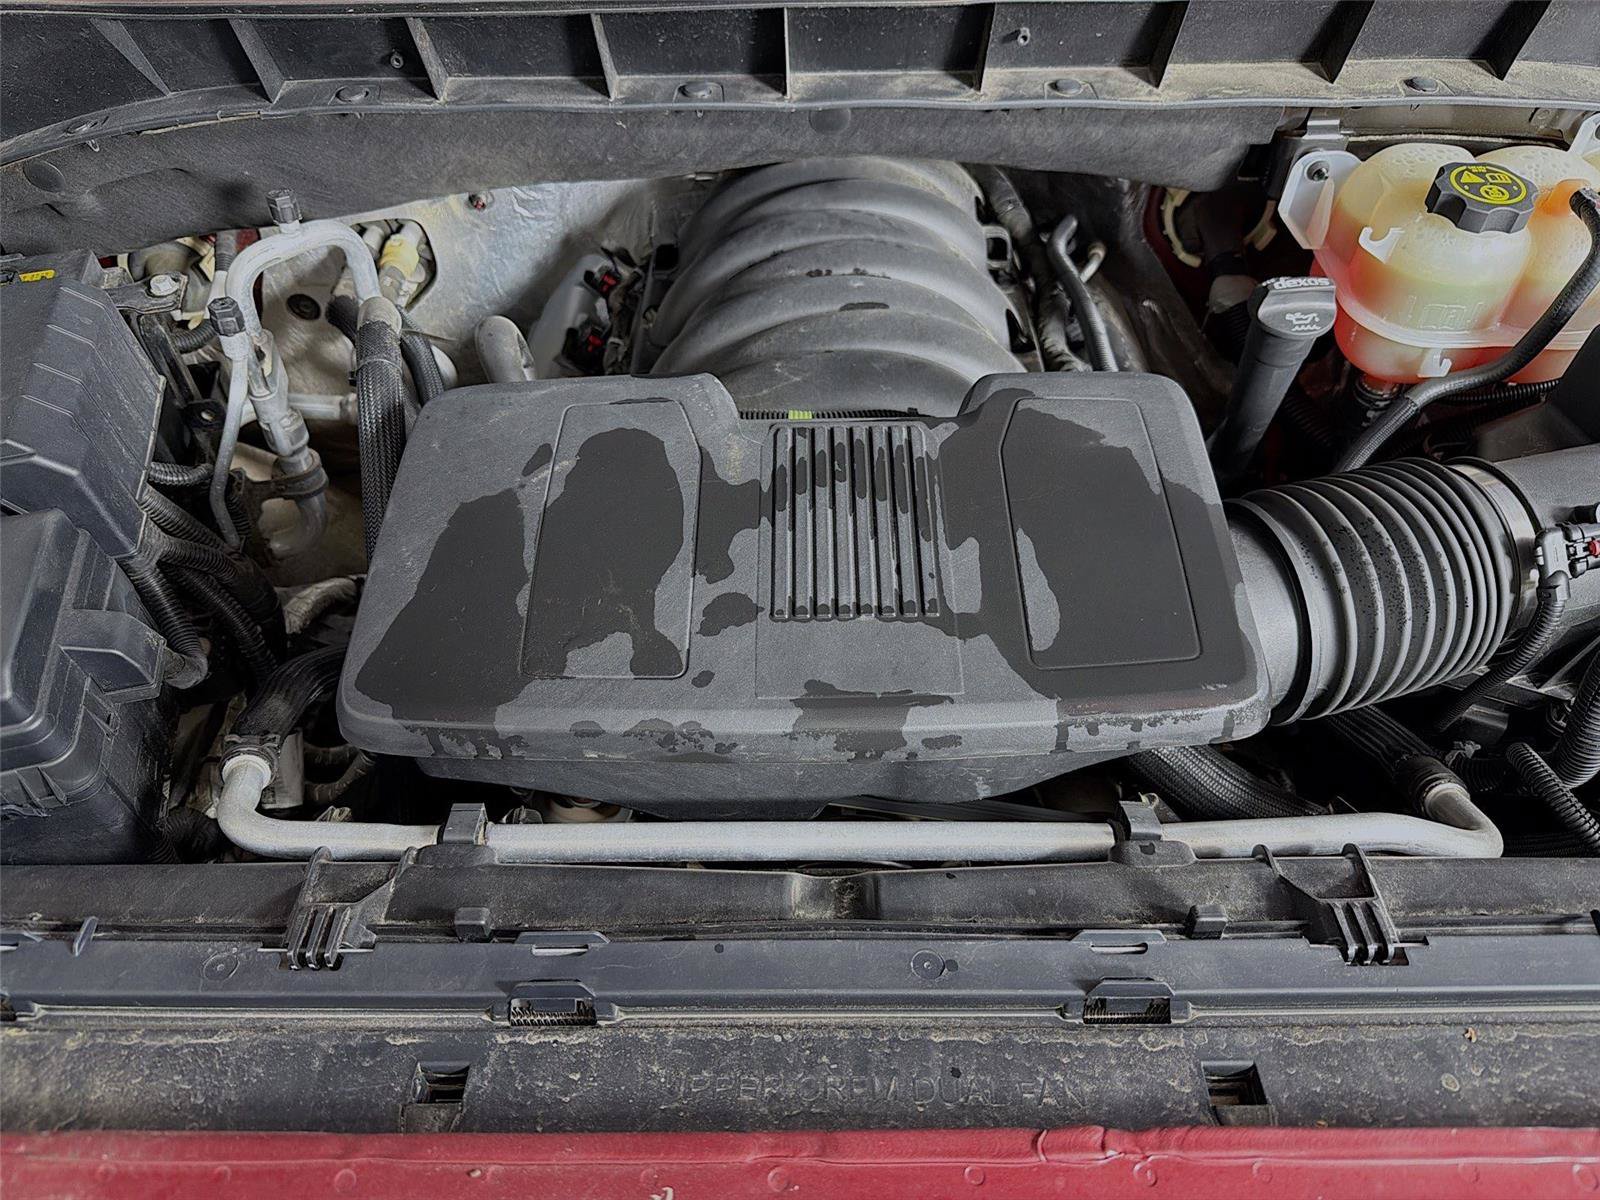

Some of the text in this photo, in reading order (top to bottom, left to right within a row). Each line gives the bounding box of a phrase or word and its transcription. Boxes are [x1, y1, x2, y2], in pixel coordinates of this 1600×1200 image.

[1273, 276, 1331, 290] dexos
[666, 1072, 785, 1101] UPPER
[911, 1074, 1010, 1108] DUAL
[1016, 1075, 1089, 1109] FAN
